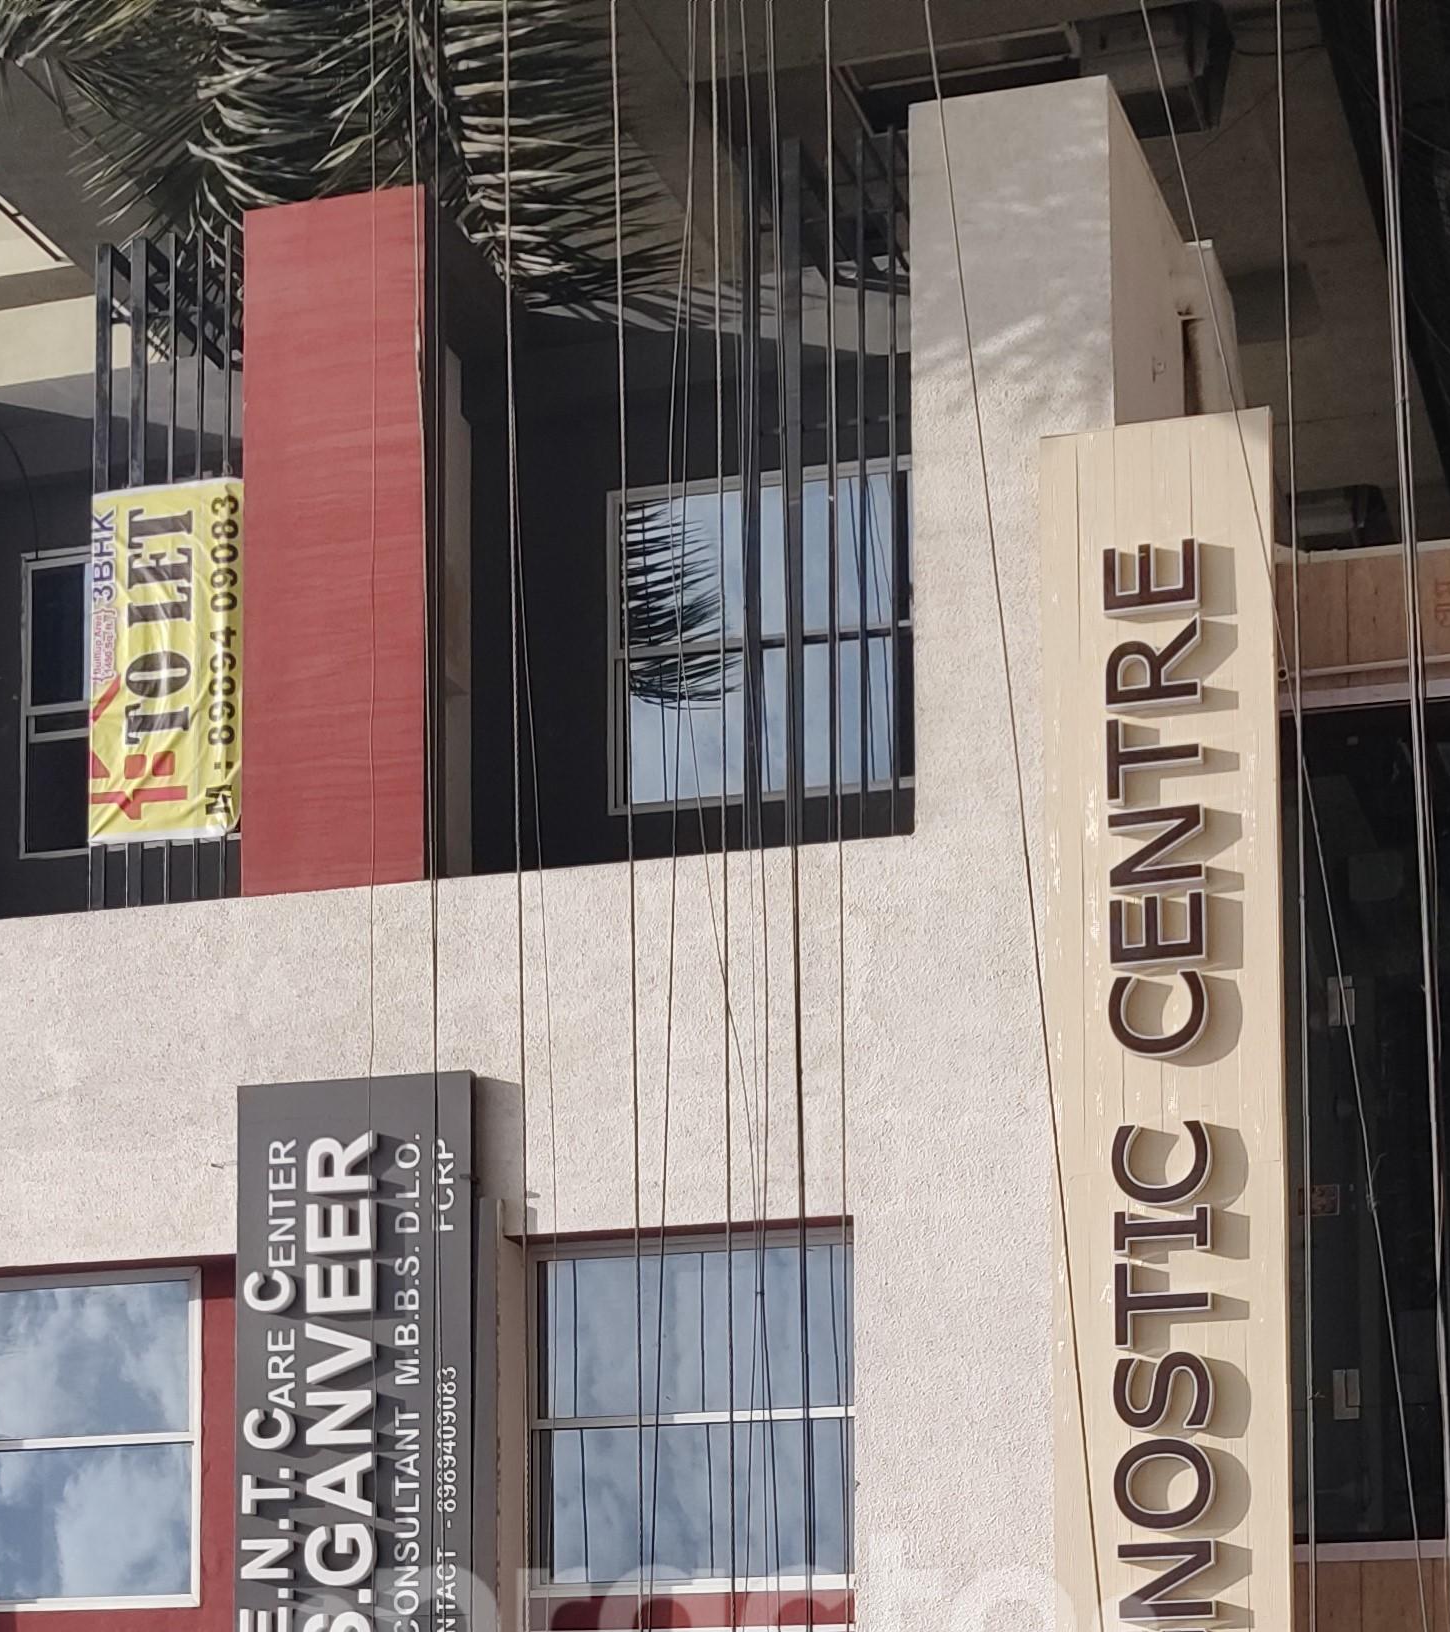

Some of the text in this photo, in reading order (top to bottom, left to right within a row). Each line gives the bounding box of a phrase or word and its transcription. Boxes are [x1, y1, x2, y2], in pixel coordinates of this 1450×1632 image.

[91, 508, 115, 601] 3BHK
[209, 495, 240, 612] 09083
[125, 507, 194, 745] TO LET
[207, 625, 238, 745] 89894
[1102, 536, 1209, 1058] CENTRE
[243, 1138, 297, 1314] CENTER
[394, 1132, 422, 1234] D.L.O.
[394, 1245, 422, 1385] M.B.B.S.
[243, 1328, 296, 1451] CARE
